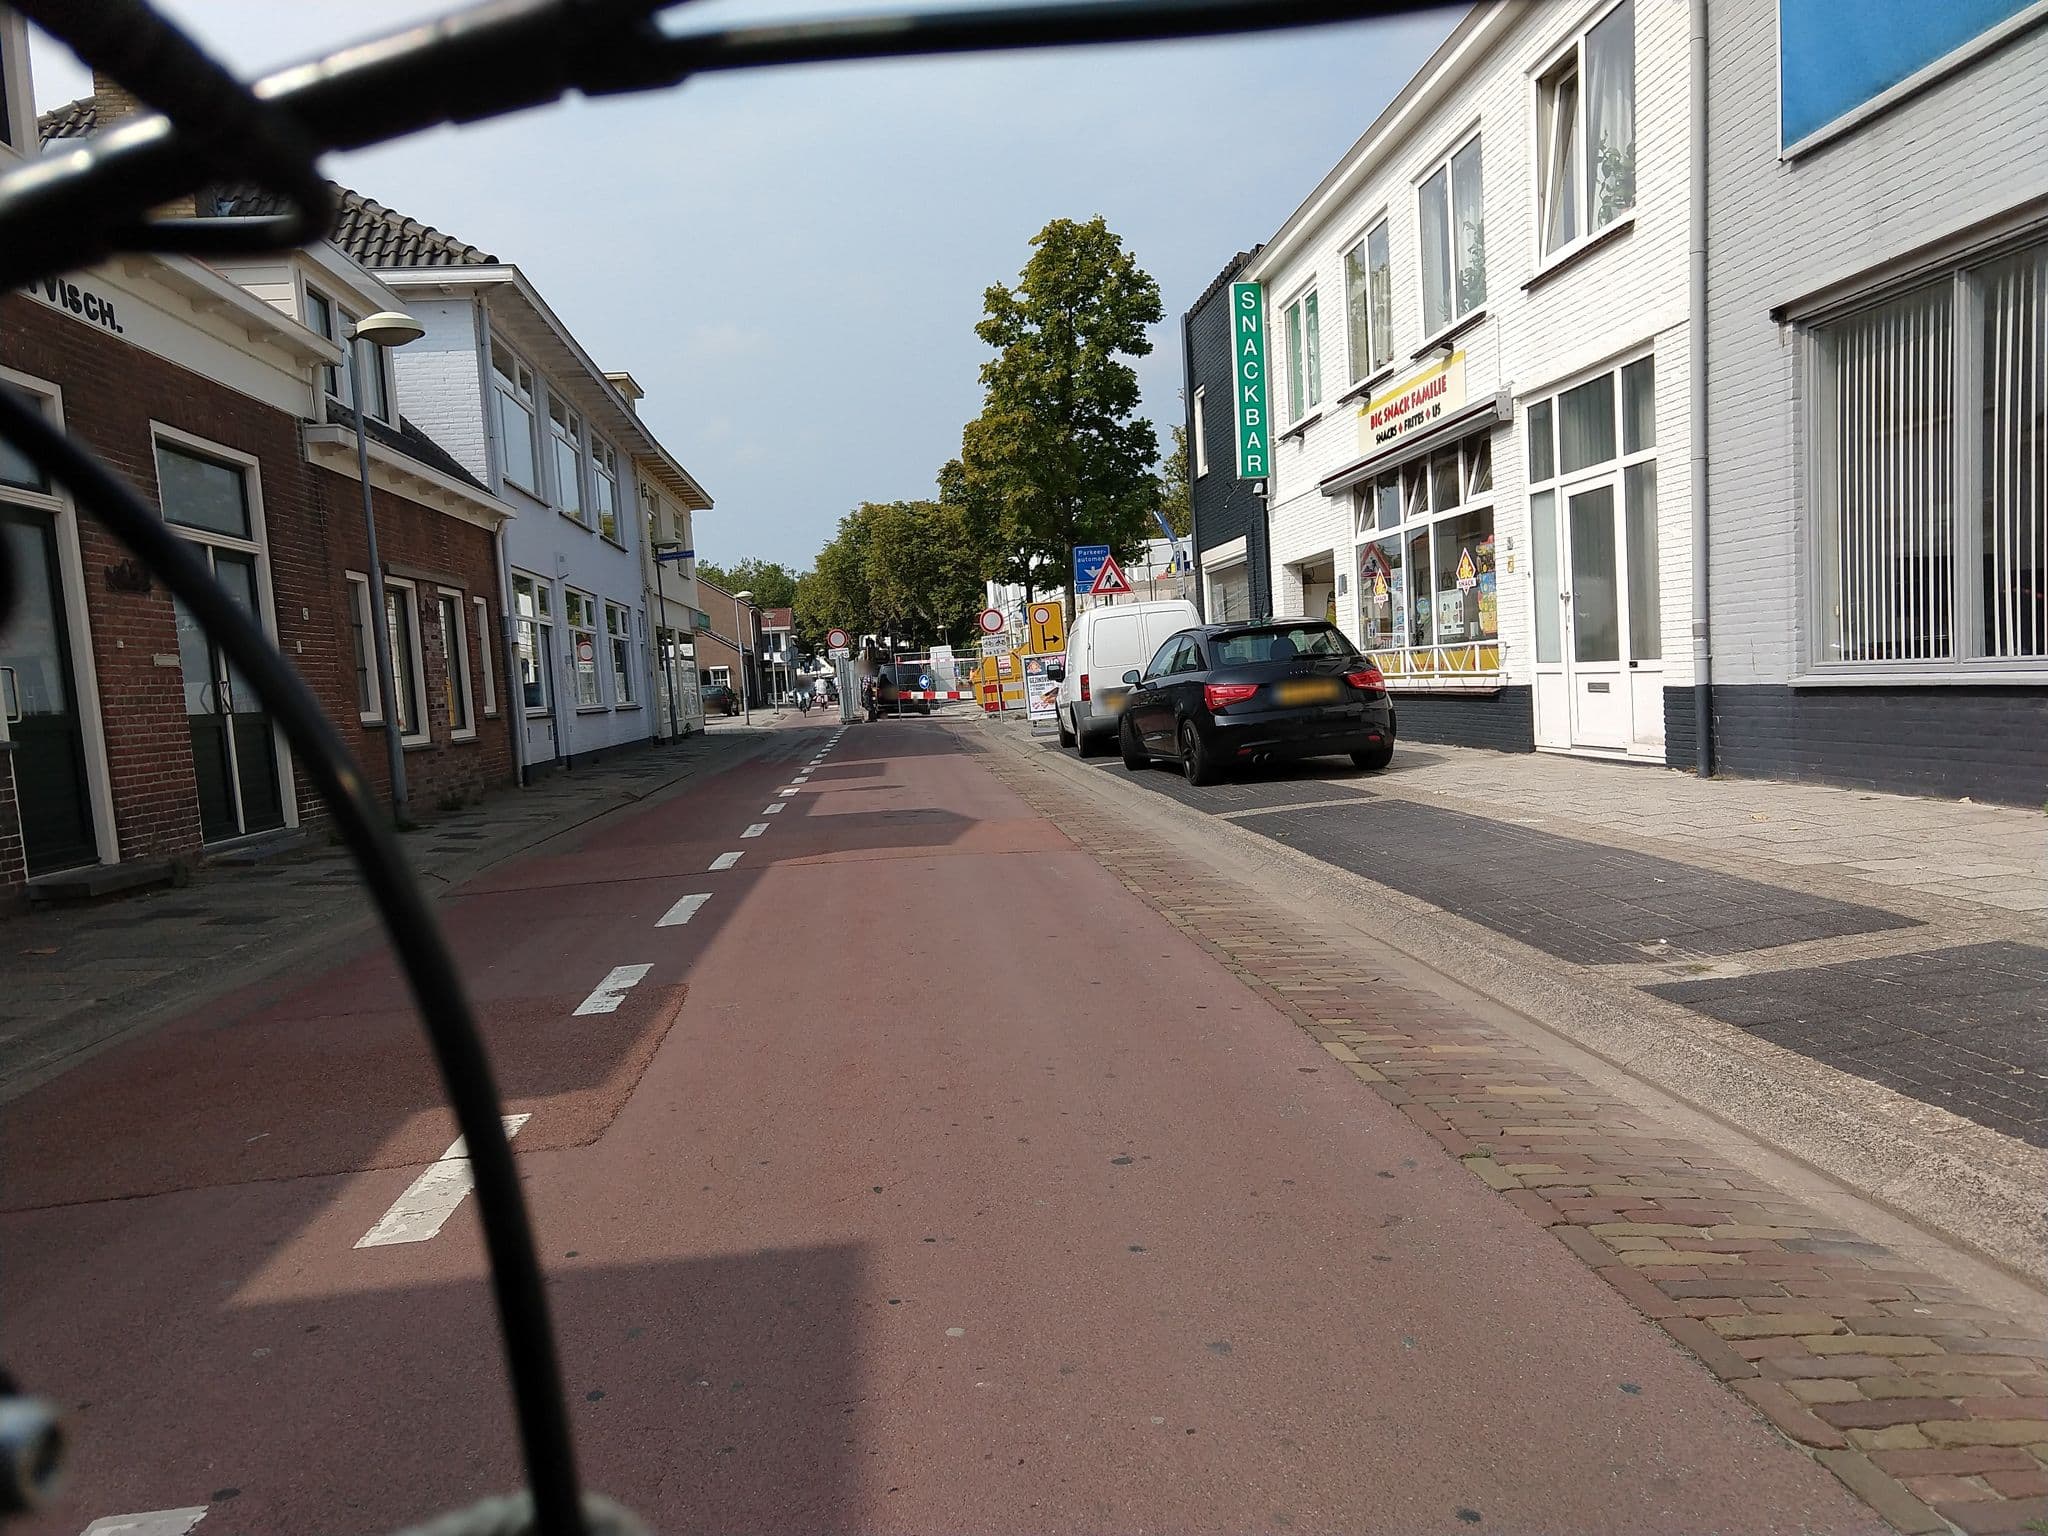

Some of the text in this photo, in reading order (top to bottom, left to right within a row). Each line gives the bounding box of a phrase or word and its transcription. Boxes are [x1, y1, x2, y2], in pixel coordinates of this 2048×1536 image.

[1241, 291, 1262, 472] SNACKBAR
[1370, 374, 1447, 430] BIG SNACK FAMILIE
[1375, 425, 1397, 446] SNACKS
[1404, 411, 1424, 431] FRITES
